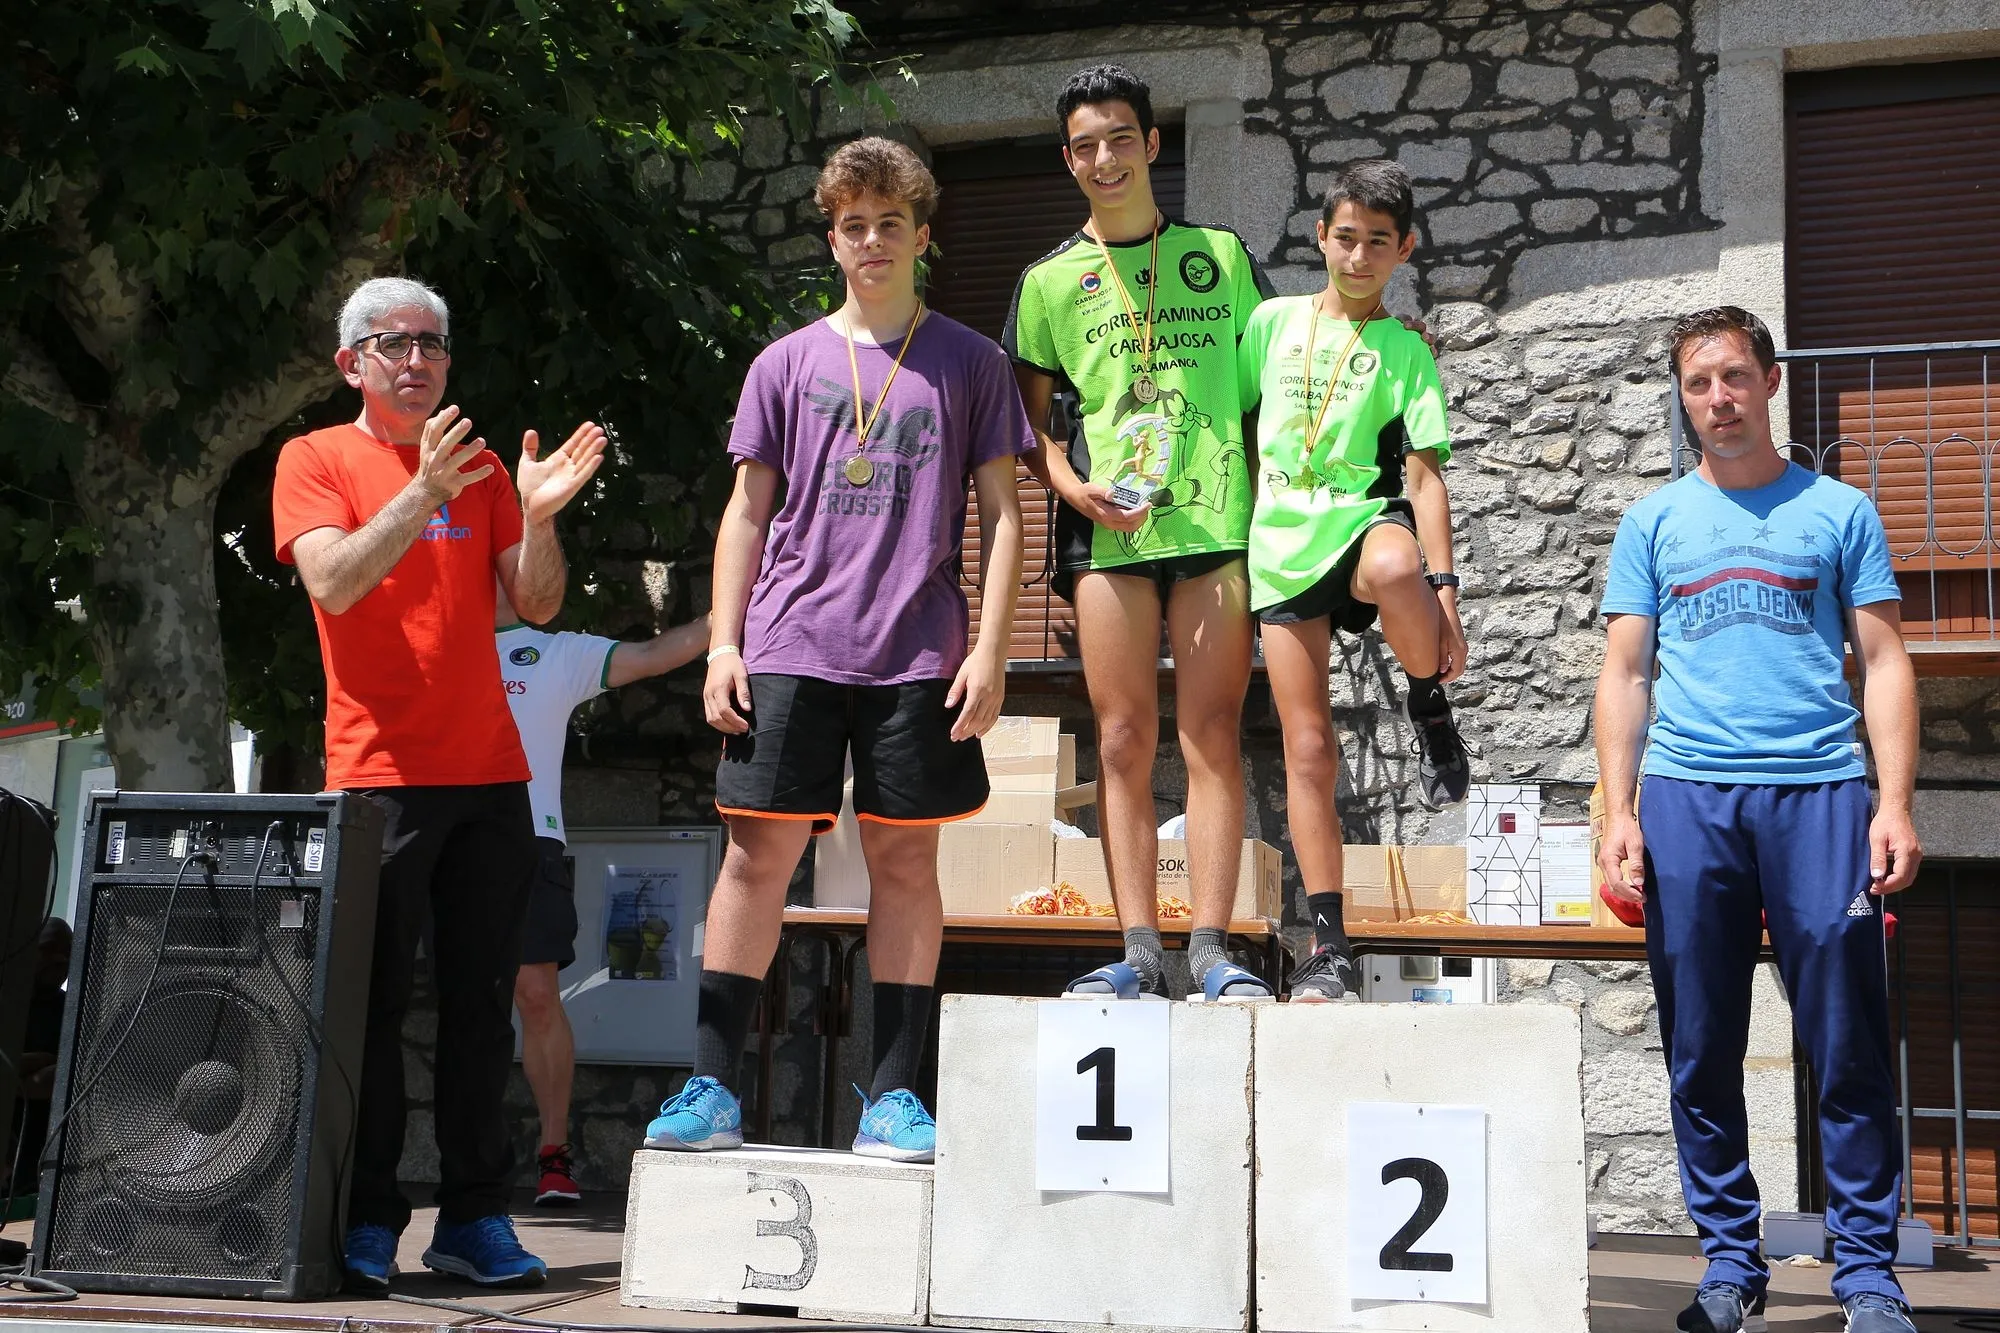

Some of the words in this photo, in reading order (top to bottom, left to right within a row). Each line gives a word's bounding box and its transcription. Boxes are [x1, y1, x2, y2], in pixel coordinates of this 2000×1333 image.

[1085, 304, 1232, 344] CORRECAMINOS
[1109, 332, 1217, 358] CARBAJOSA
[1279, 376, 1365, 391] CORRECAINOS
[1285, 389, 1348, 402] CARBAOSA
[819, 493, 909, 518] CROSSFIT
[1676, 583, 1750, 627] CLASSIC
[1757, 584, 1814, 625] DENIM
[502, 680, 526, 694] es
[1076, 1047, 1132, 1141] 1
[741, 1171, 818, 1291] 3
[1379, 1157, 1453, 1272] 2
